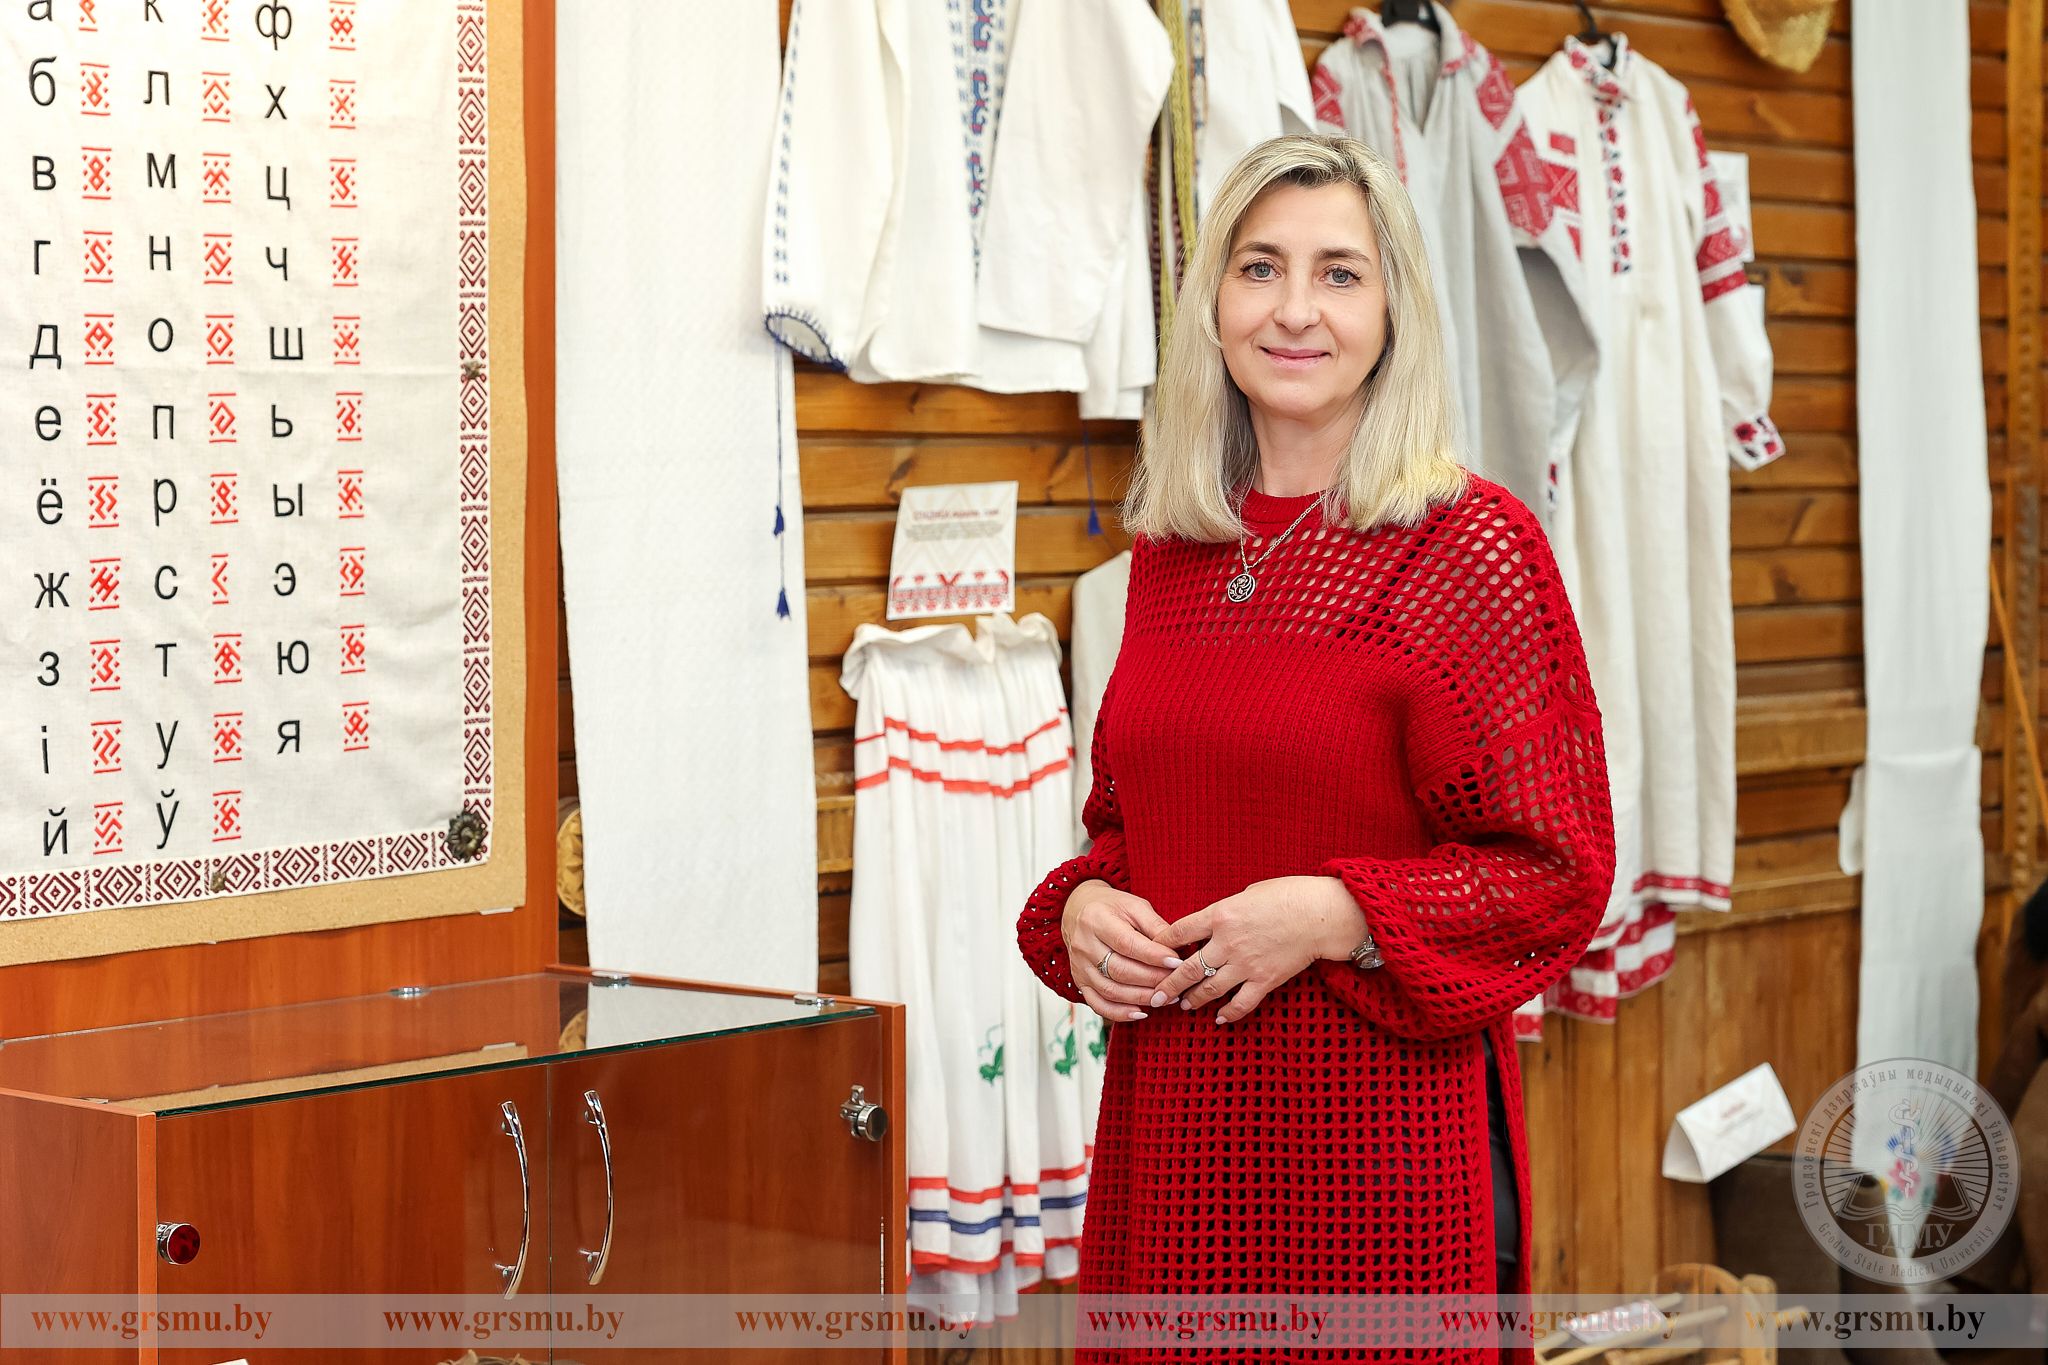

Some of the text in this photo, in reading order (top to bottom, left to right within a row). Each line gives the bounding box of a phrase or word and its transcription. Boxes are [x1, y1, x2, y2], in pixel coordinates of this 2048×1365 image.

[256, 0, 292, 51] ф
[29, 56, 57, 107] б
[143, 70, 170, 106] л
[265, 84, 287, 120] х
[32, 155, 57, 191] в
[147, 152, 177, 189] м
[266, 165, 291, 211] ц
[34, 239, 51, 275] г
[149, 235, 172, 271] н
[266, 246, 288, 281] ч
[29, 324, 62, 370] д
[148, 317, 174, 353] о
[269, 326, 304, 361] ш
[35, 405, 62, 442] е
[152, 405, 175, 440] п
[271, 404, 293, 438] ь
[36, 478, 63, 525] ё
[153, 478, 178, 527] р
[272, 483, 303, 518] ы
[33, 572, 70, 609] ж
[154, 565, 179, 600] с
[273, 562, 297, 597] э
[37, 651, 60, 687] з
[154, 642, 177, 678] т
[277, 640, 310, 676] ю
[41, 725, 50, 774] і
[155, 720, 179, 770] у
[277, 719, 301, 755] я
[43, 806, 68, 857] й
[156, 788, 180, 850] ў
